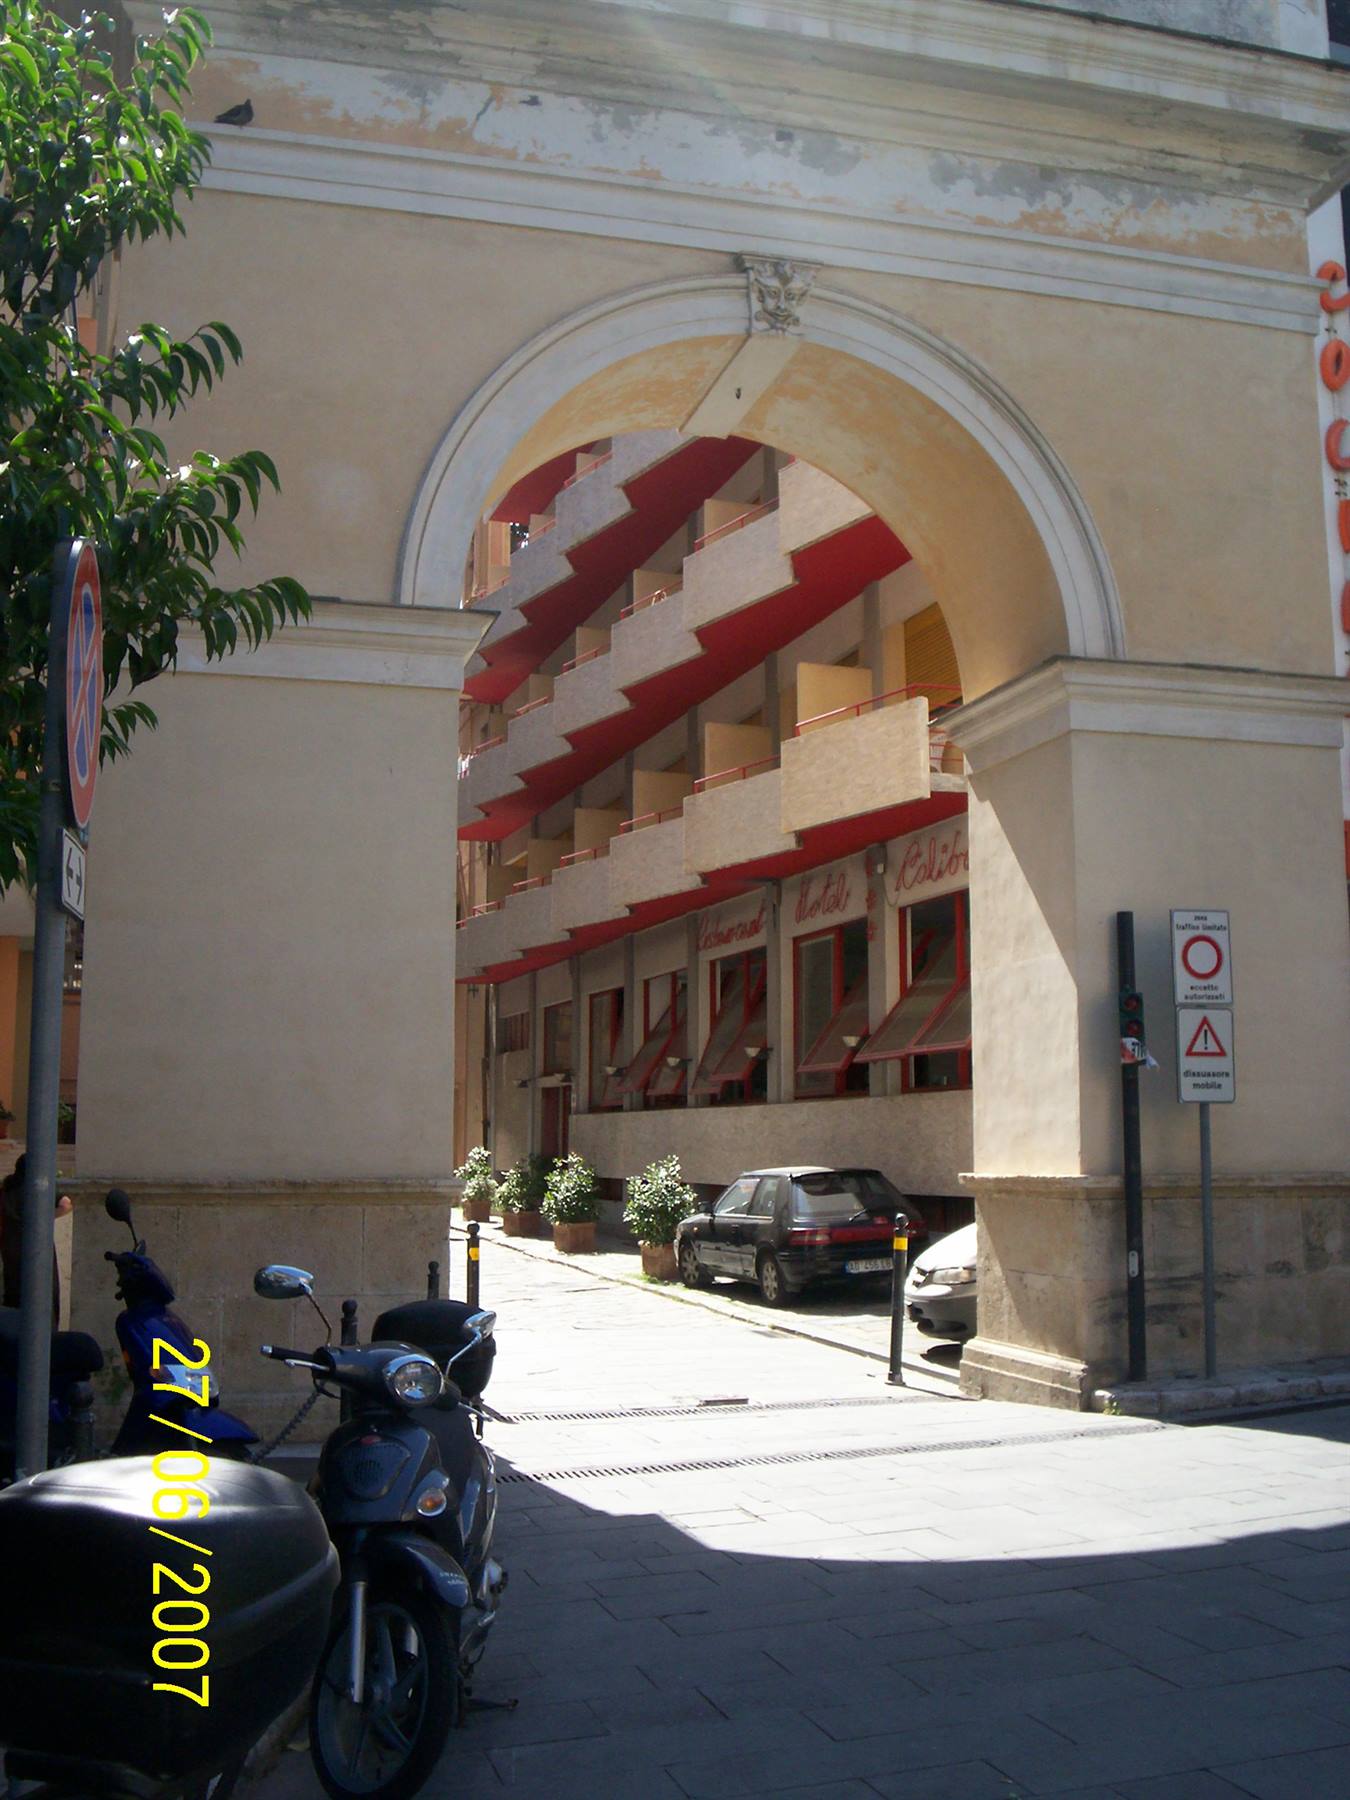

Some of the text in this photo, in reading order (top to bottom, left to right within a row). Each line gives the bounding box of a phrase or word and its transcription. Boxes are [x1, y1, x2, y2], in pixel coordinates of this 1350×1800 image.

[795, 872, 849, 924] Hotel
[1183, 1069, 1230, 1078] dissuasore
[1192, 1081, 1222, 1089] mobile
